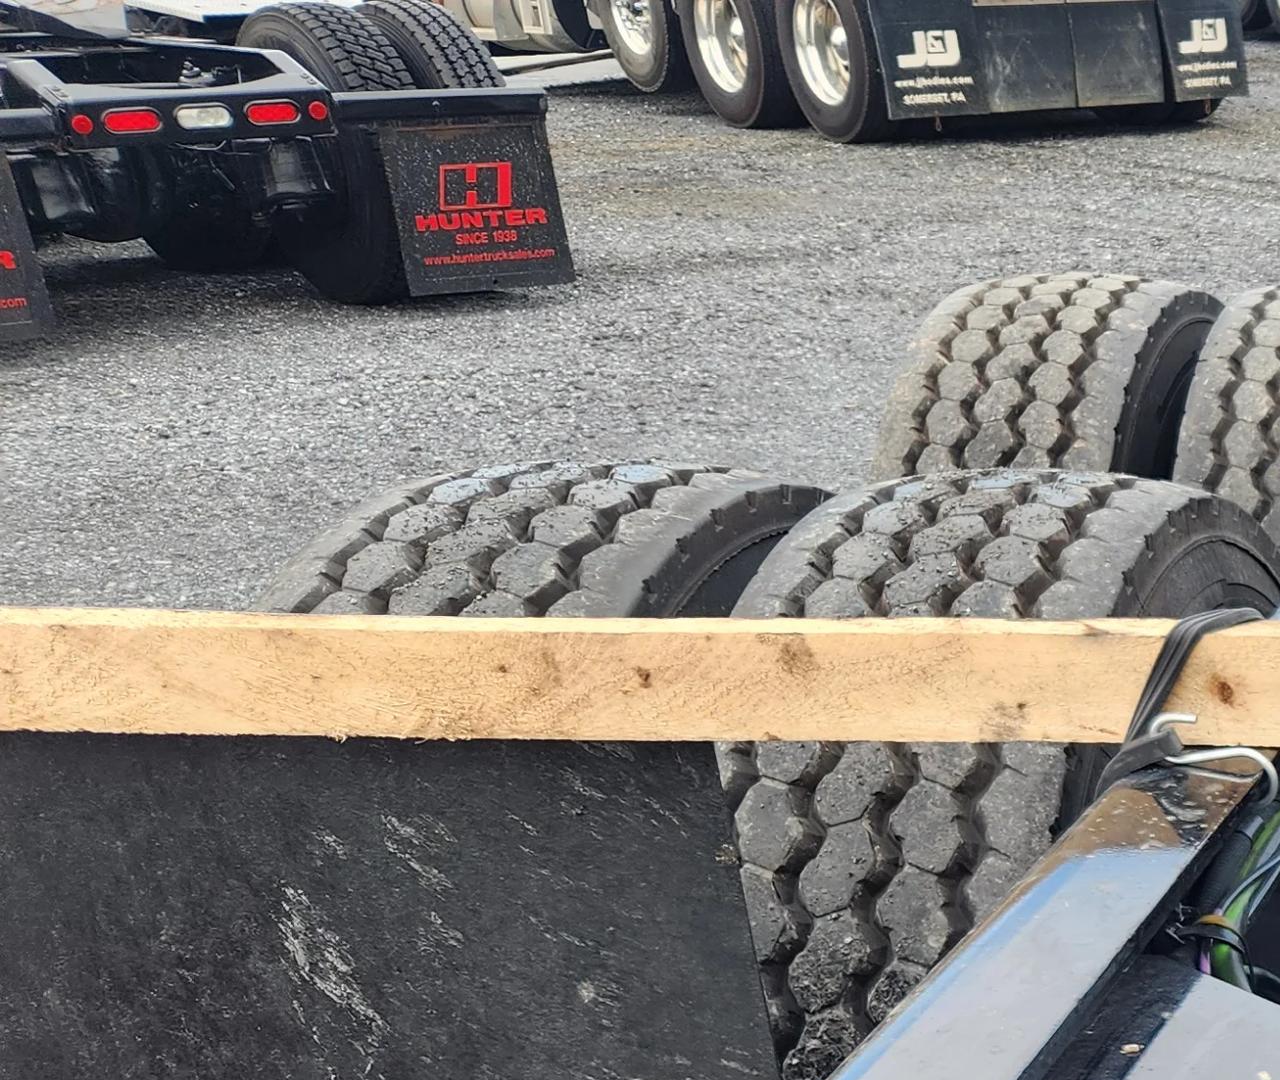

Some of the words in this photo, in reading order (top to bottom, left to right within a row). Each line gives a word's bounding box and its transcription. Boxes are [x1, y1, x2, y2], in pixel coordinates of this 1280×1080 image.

[415, 208, 548, 231] HUNTER
[455, 231, 489, 245] SINCE
[492, 230, 518, 244] 1938
[423, 248, 556, 266] www.huntertrucksales.com
